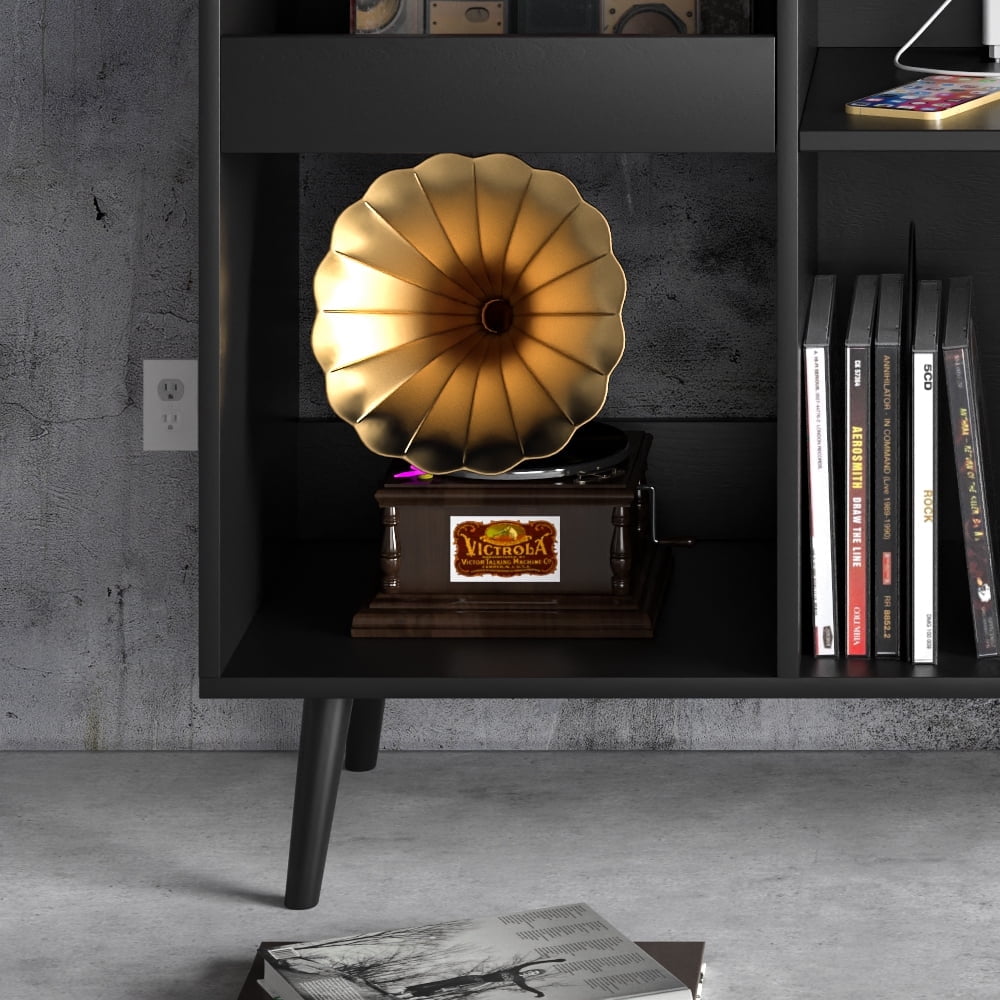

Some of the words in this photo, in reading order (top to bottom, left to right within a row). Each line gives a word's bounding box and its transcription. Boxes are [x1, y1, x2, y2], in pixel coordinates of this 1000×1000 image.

[883, 355, 891, 410] ANNIHILATOR
[924, 364, 932, 390] 5CD
[883, 419, 891, 427] IN
[852, 425, 863, 488] AEROSMITH
[883, 429, 891, 475] COMMAND
[853, 498, 862, 523] DRAW
[924, 490, 933, 523] ROCK
[460, 533, 550, 557] VICTROLA
[853, 527, 862, 543] THE
[853, 546, 862, 566] LINE
[853, 606, 861, 646] COLUMBIA
